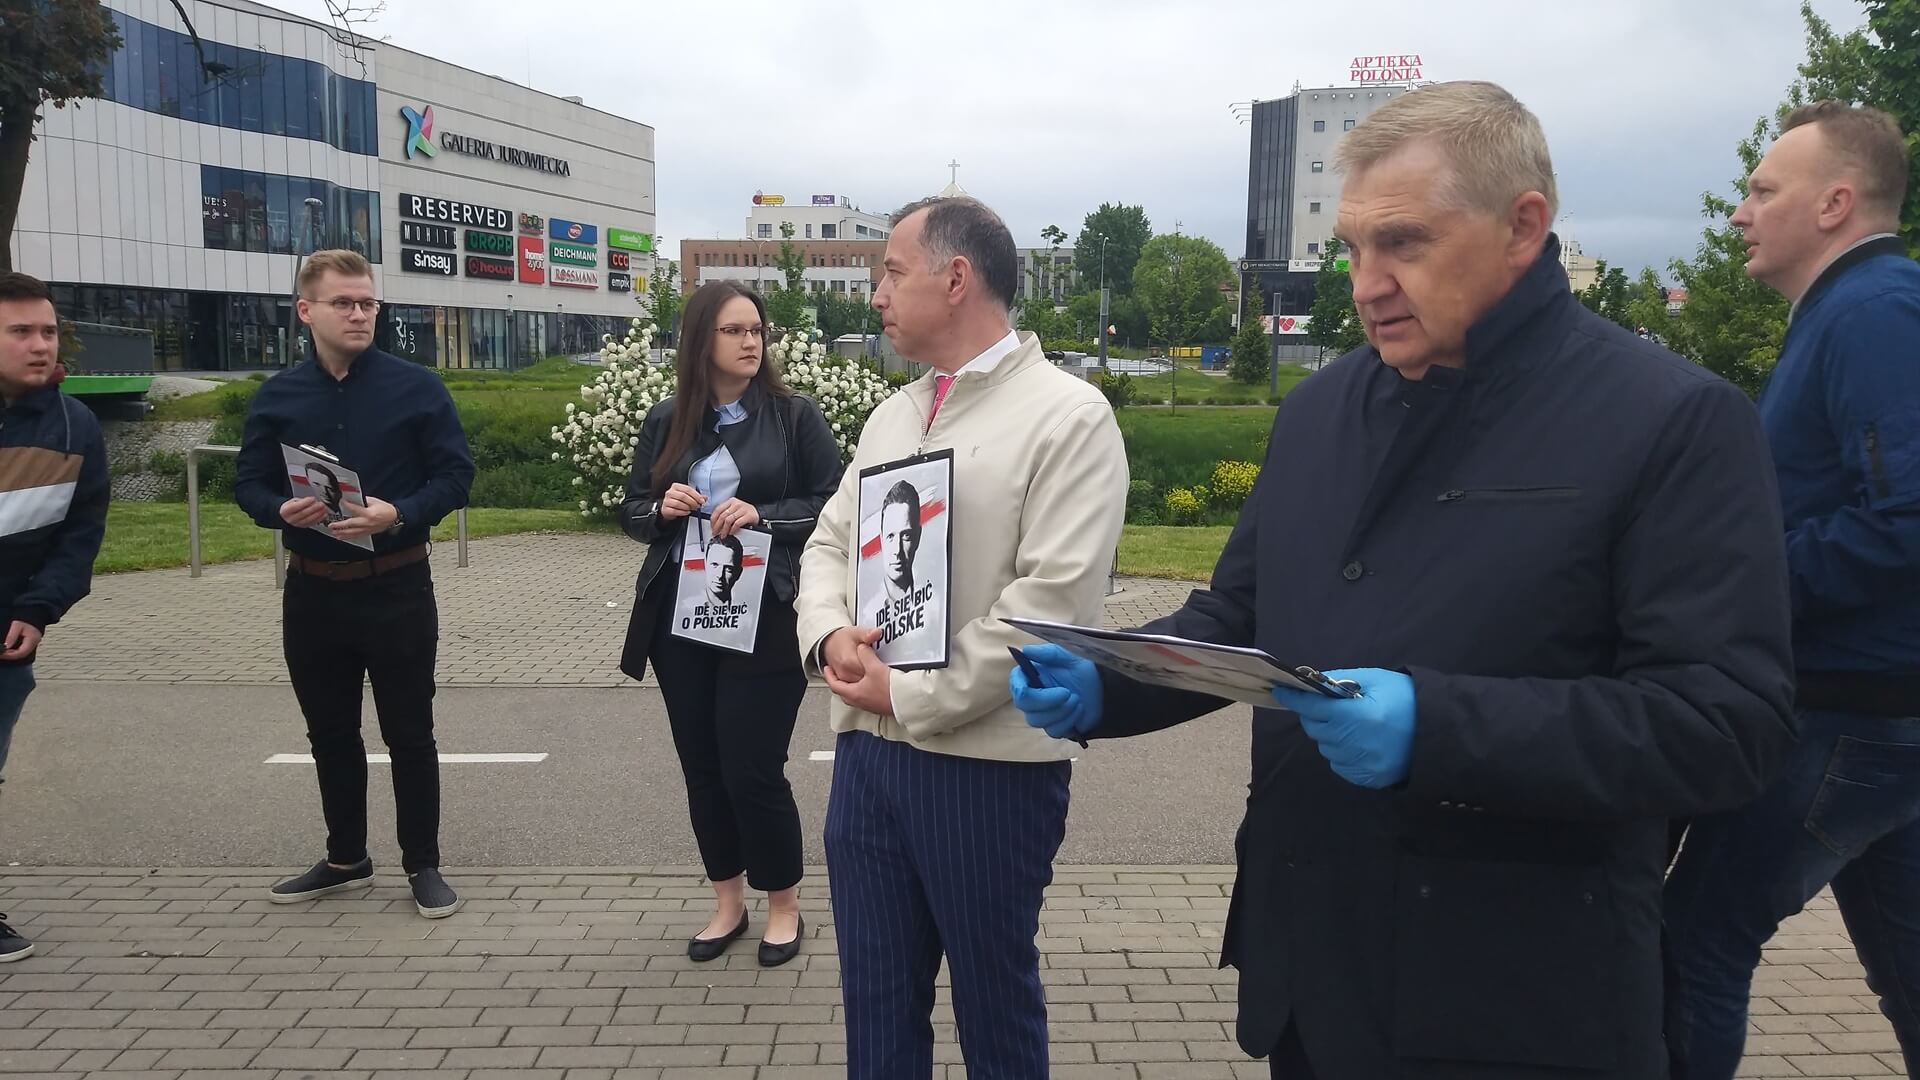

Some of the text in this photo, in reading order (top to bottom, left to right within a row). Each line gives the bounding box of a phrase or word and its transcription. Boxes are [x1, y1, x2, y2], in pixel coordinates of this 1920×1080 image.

[1350, 55, 1423, 68] APTEKA
[1350, 68, 1422, 81] POLONIA
[441, 131, 570, 176] GALERIA JUROWIECKA
[411, 195, 507, 229] RESERVED
[469, 231, 513, 252] CROPP
[554, 247, 597, 262] DEICHMANN
[612, 255, 629, 267] CCC
[414, 250, 451, 275] sinsay
[555, 268, 598, 284] ROSSMANN
[611, 276, 630, 290] empik
[682, 617, 690, 630] O
